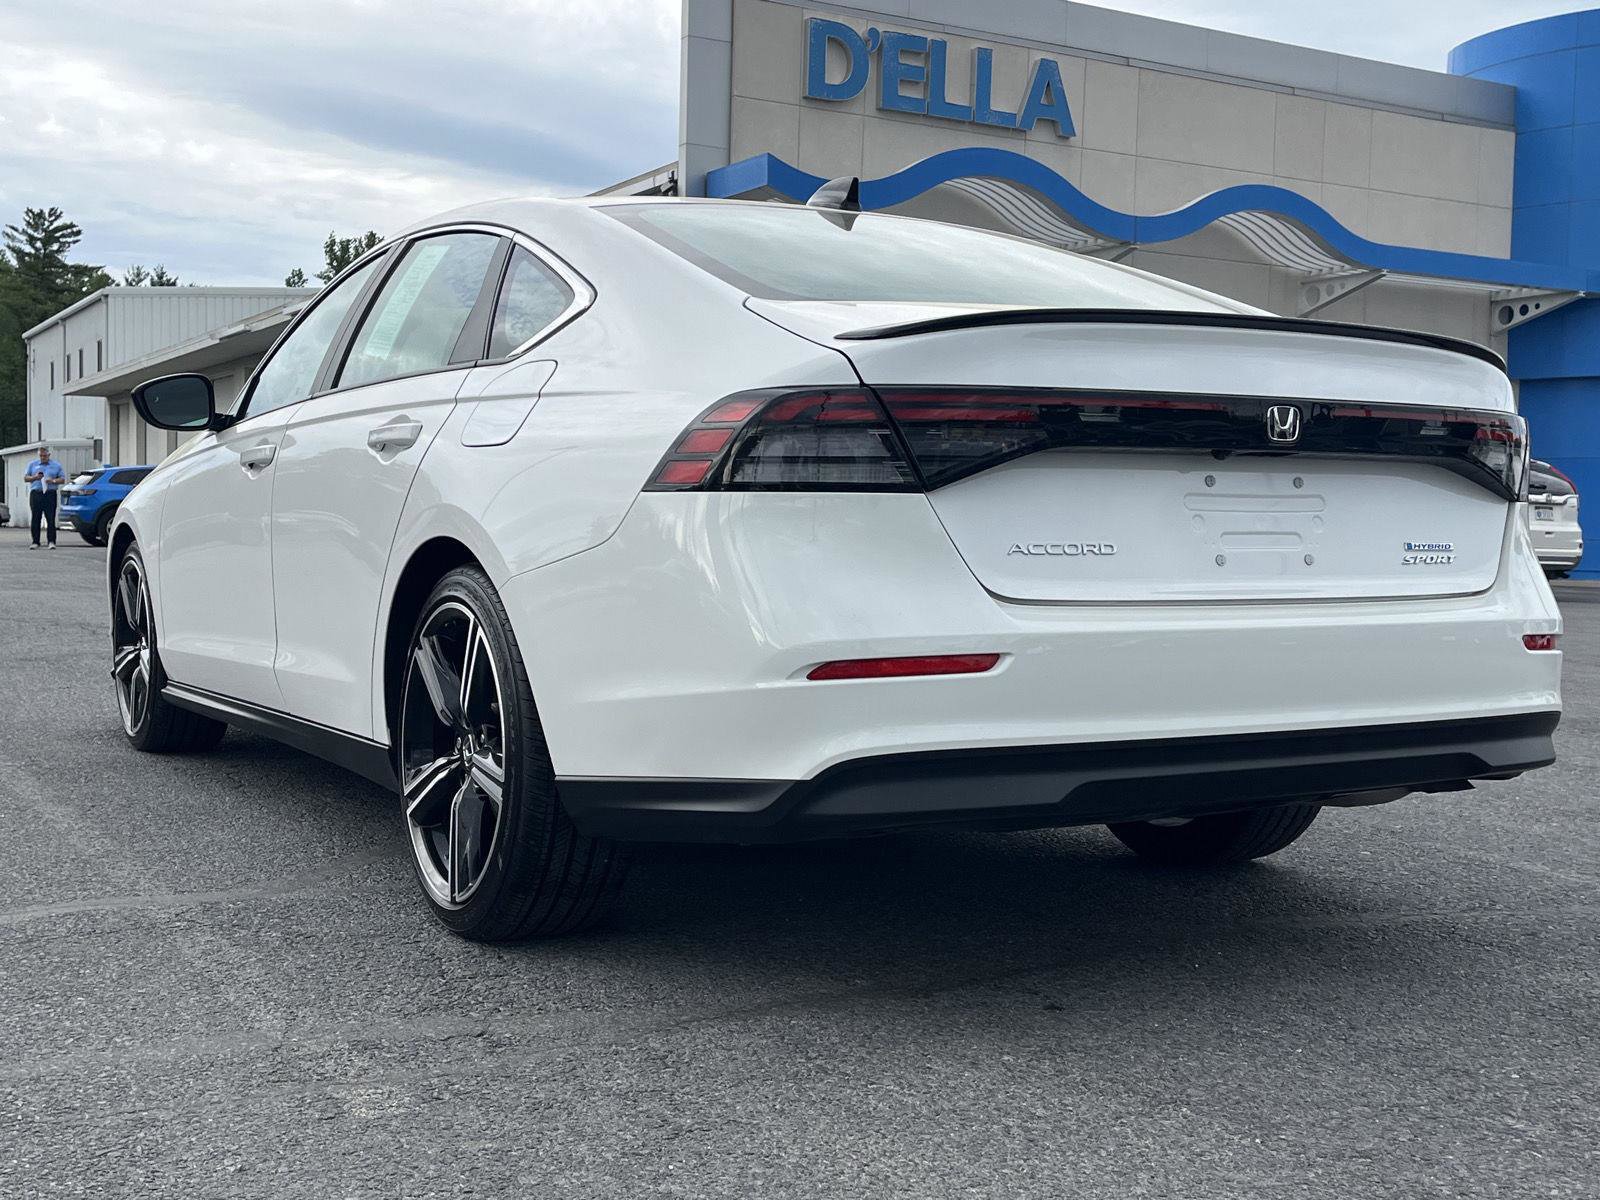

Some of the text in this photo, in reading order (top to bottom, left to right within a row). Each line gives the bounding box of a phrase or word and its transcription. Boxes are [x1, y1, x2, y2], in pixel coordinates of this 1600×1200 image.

[804, 17, 1076, 138] D'ELLA
[1007, 543, 1119, 556] ACCORD
[1401, 554, 1456, 565] SPORT
